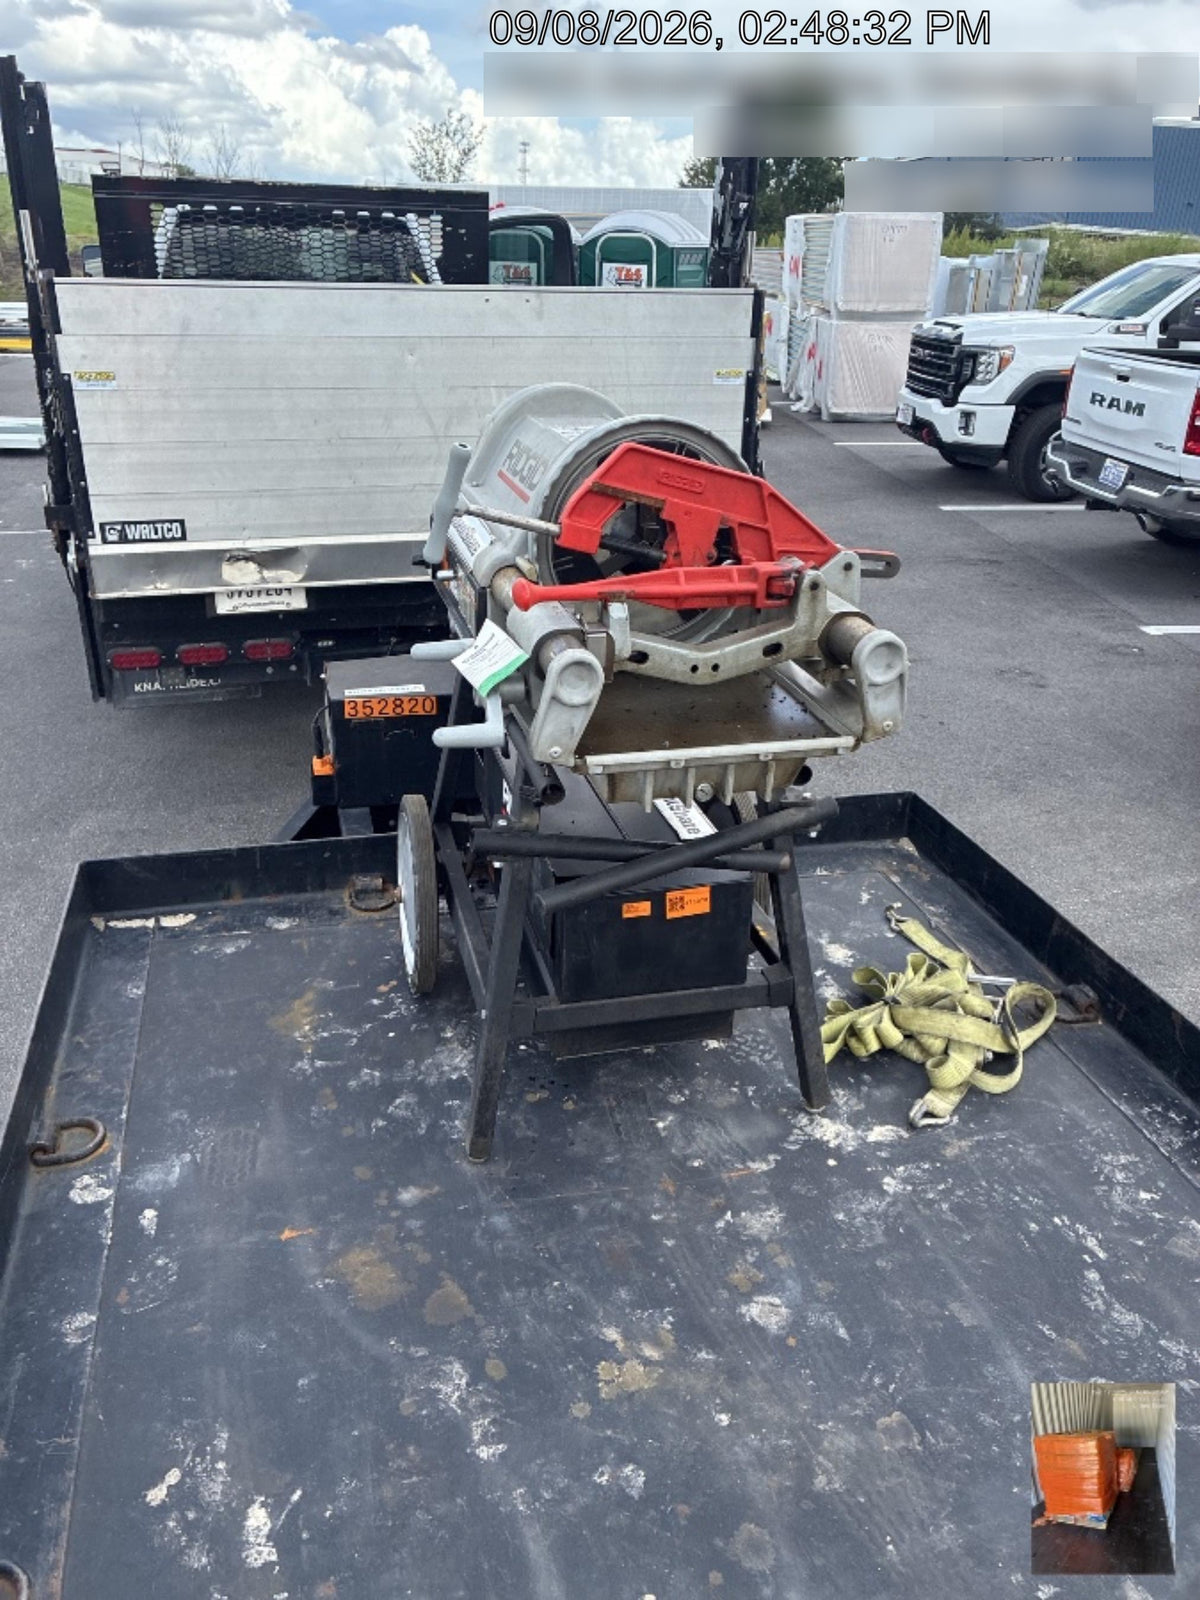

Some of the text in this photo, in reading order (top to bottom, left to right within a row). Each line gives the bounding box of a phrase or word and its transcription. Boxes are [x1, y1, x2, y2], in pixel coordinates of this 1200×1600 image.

[1089, 391, 1146, 417] RAM
[124, 522, 182, 540] WALTCO
[347, 697, 435, 718] 352820
